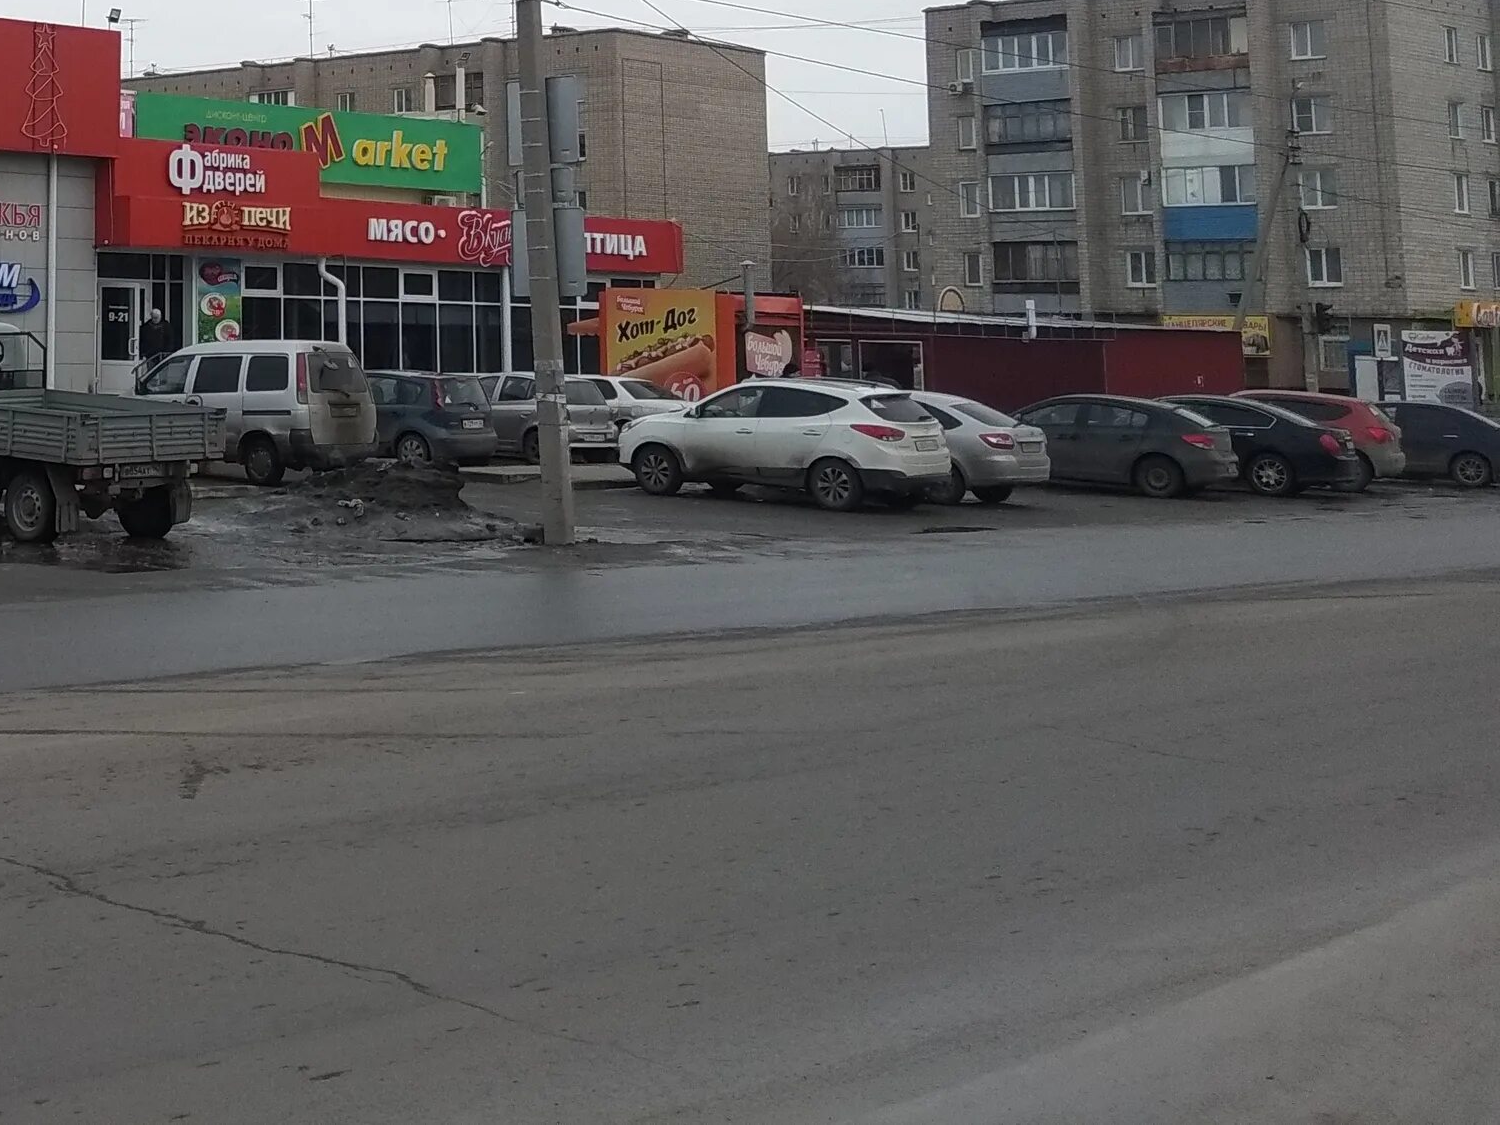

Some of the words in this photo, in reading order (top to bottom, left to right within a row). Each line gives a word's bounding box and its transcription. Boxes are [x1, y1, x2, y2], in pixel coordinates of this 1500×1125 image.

[108, 311, 129, 323] 9-21
[618, 308, 697, 343] Хот-Дог
[754, 354, 784, 377] Чебуре
